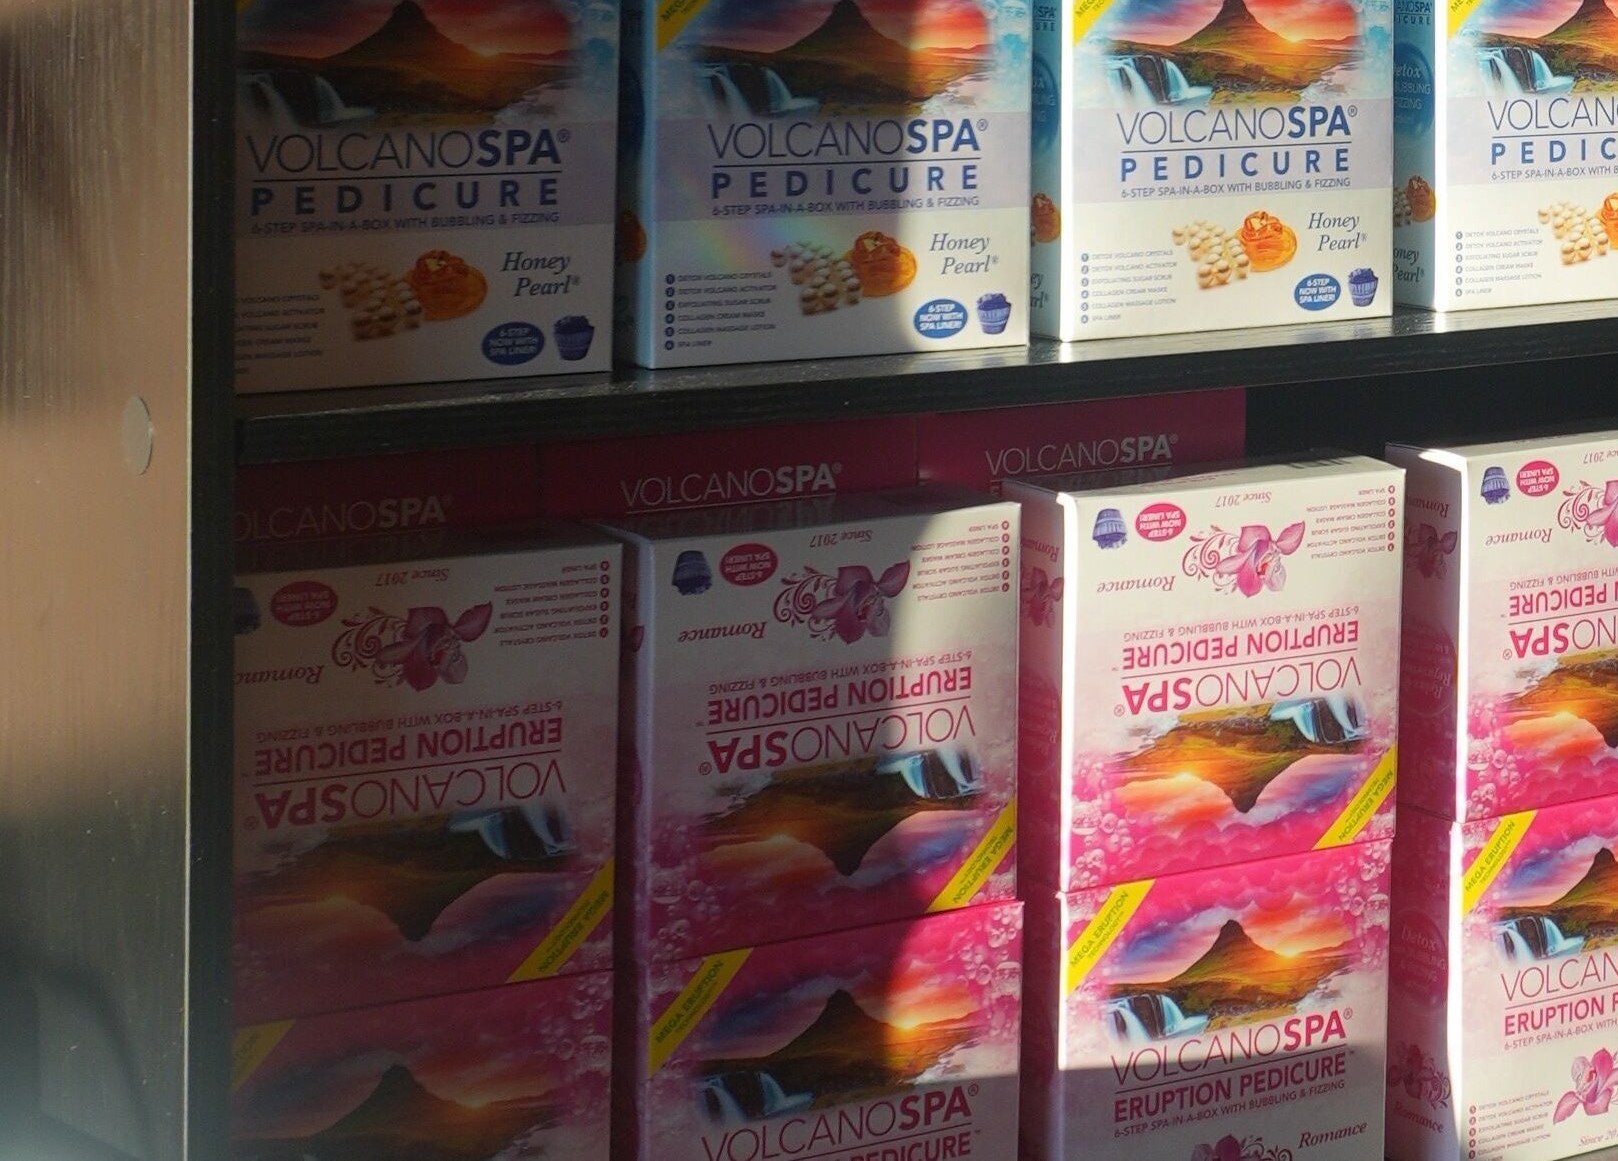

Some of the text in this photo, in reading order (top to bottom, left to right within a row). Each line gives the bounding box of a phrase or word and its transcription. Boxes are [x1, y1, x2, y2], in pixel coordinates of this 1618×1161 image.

[1121, 149, 1348, 182] PEDICURE
[712, 165, 978, 199] PEDICURE
[1121, 178, 1351, 198] 6-STEP SPA-IN-A-BOX WITH BUBBLING & FIZZING
[252, 179, 558, 216] PEDICURE
[1309, 213, 1360, 231] Honey
[930, 234, 989, 253] Honey
[501, 251, 570, 273] Honey
[1583, 451, 1604, 465] 2017
[1486, 528, 1553, 546] Romance
[1096, 575, 1176, 593] Romance
[678, 621, 767, 642] Romance
[1247, 621, 1359, 647] ERUPTION
[848, 667, 971, 706] ERUPTION
[418, 717, 563, 759] ERUPTION
[1504, 995, 1605, 1036] ERUPTION
[1115, 1078, 1232, 1123] ERUPTION
[1298, 1122, 1367, 1149] Romance
